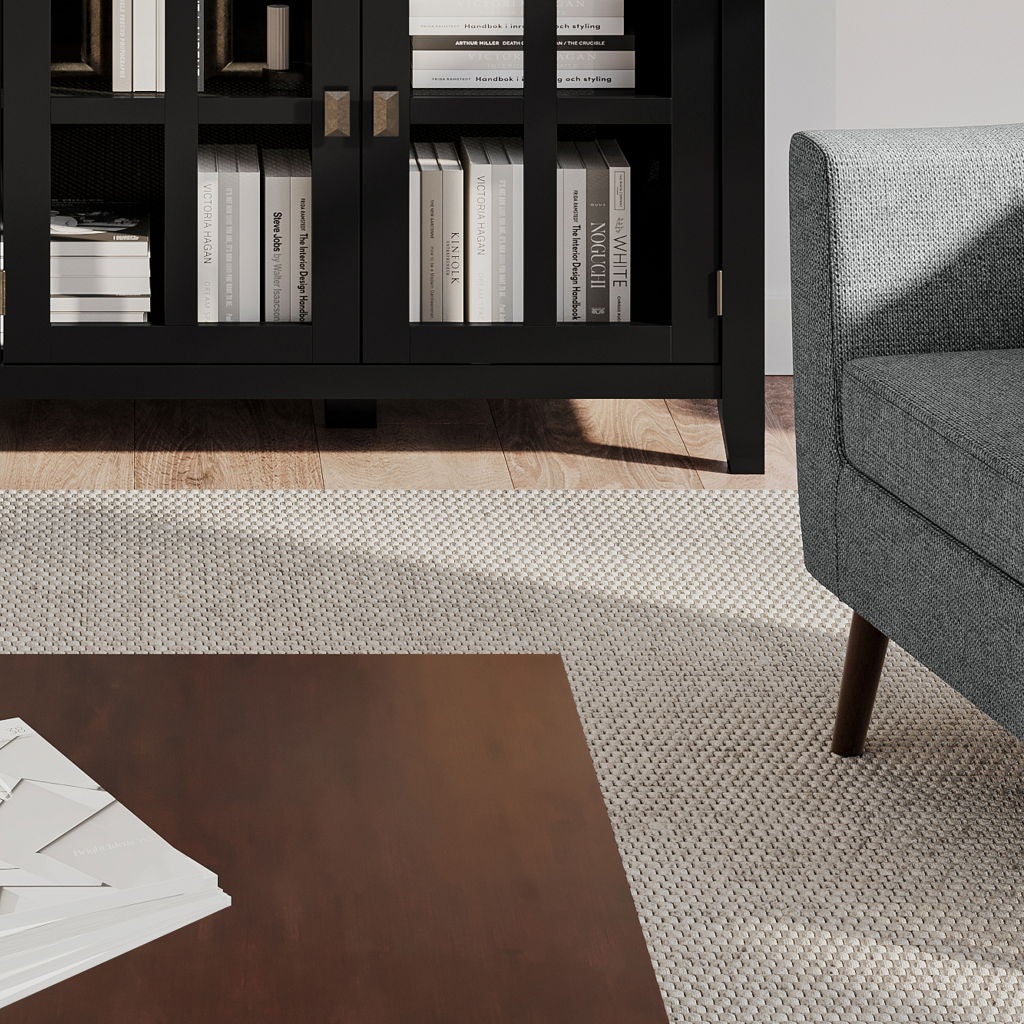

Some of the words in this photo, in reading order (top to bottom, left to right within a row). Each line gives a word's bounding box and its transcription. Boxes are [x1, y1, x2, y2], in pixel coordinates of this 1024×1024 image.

[584, 76, 612, 84] styling
[204, 184, 212, 226] VICTORIA
[476, 175, 486, 219] VICTORIA
[273, 212, 282, 232] Steve
[572, 225, 581, 236] The
[204, 230, 212, 264] HAGAN
[273, 234, 282, 252] Jobs
[300, 234, 308, 245] The
[476, 222, 486, 256] HAGAN
[572, 238, 581, 261] Interior
[272, 254, 281, 262] by
[300, 246, 308, 270] Interior
[450, 232, 461, 284] KINFOLK
[590, 222, 606, 288] NOGUCHI
[613, 235, 627, 288] WHITE
[273, 264, 282, 287] Walter
[298, 272, 308, 294] Design
[570, 263, 581, 285] Design
[273, 288, 282, 321] Isaacson
[572, 286, 581, 320] Handbook
